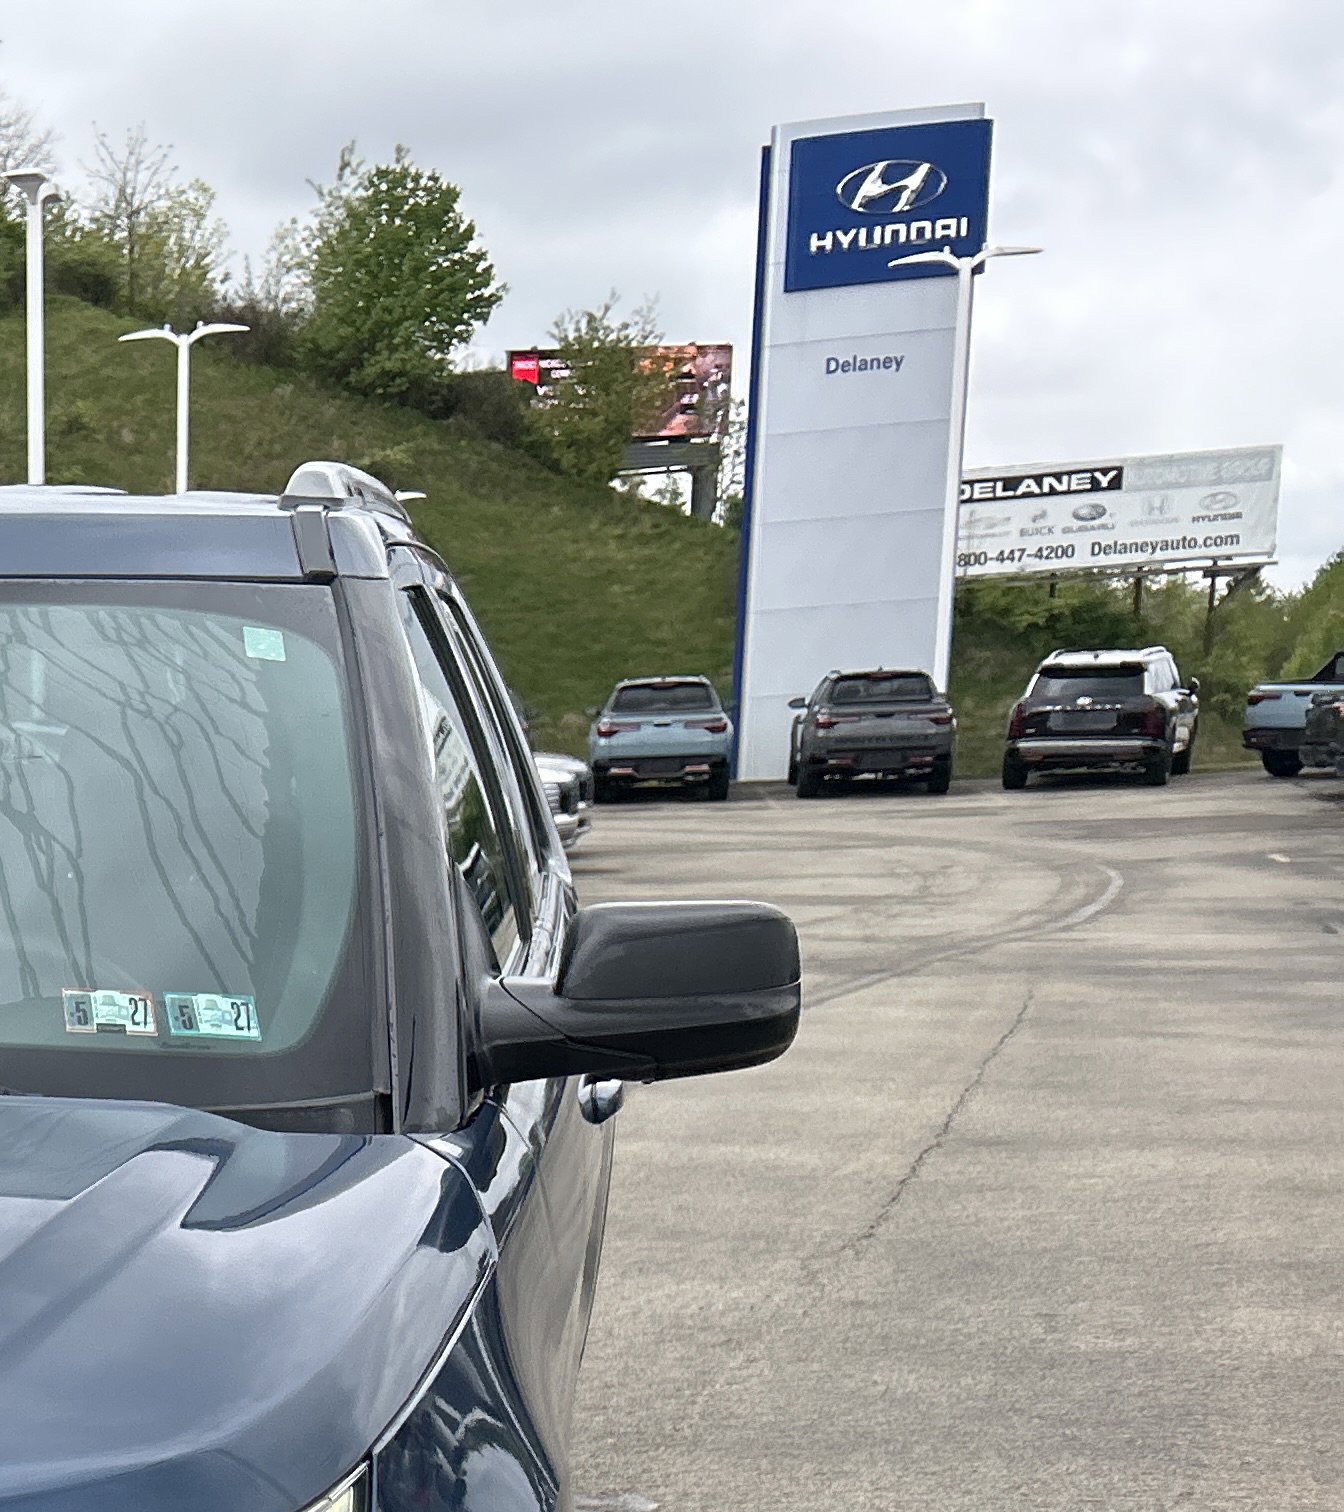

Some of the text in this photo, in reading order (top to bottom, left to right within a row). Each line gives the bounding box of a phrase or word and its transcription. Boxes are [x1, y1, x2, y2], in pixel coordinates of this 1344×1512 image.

[810, 216, 969, 254] HYUNDAI
[825, 354, 905, 375] Delaney
[960, 470, 1118, 499] DELANEY
[957, 532, 1241, 568] 800-447-4200 Delaneyauto.com
[128, 997, 149, 1029] 27
[230, 1001, 252, 1033] 27
